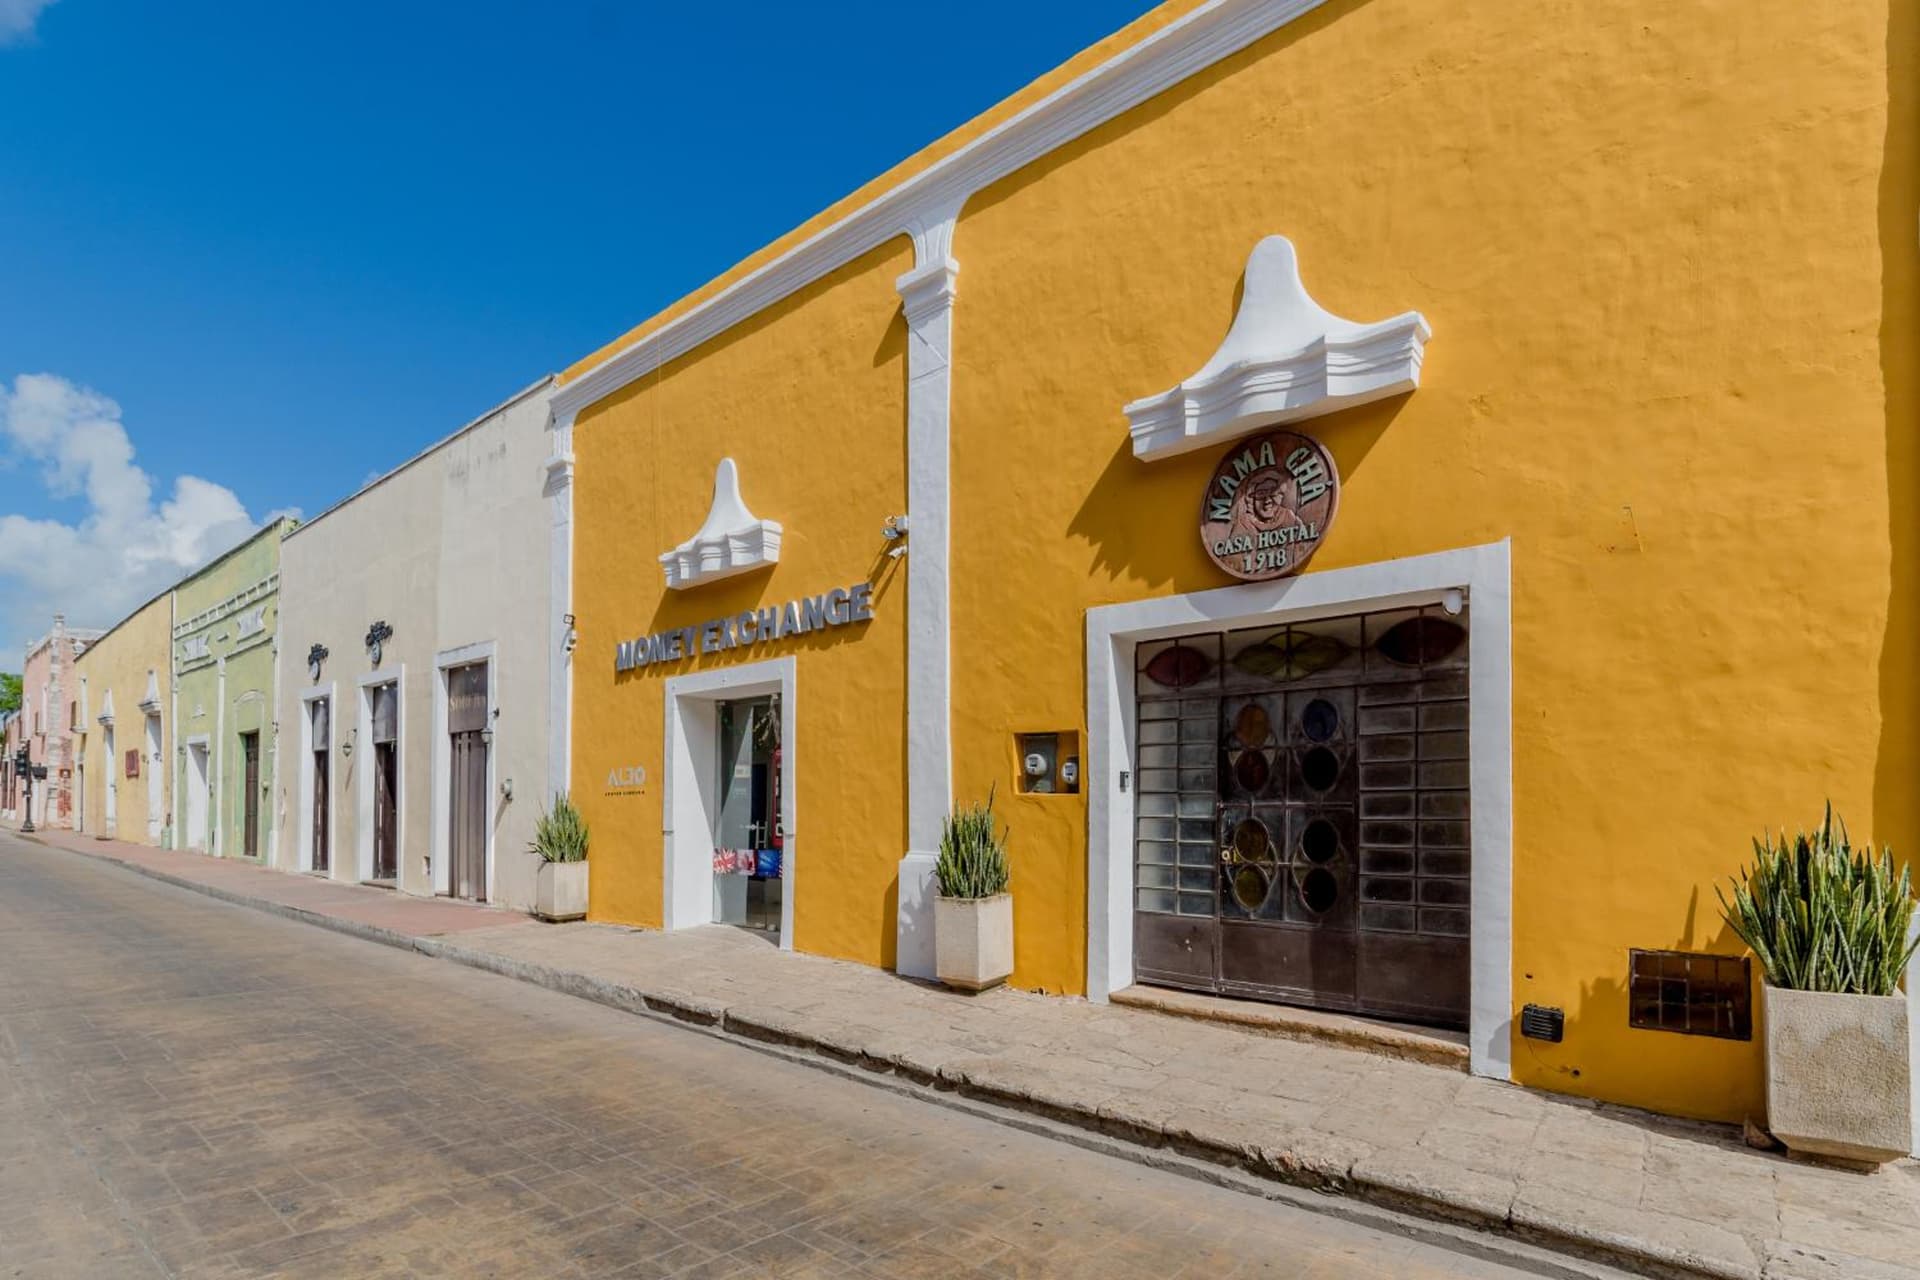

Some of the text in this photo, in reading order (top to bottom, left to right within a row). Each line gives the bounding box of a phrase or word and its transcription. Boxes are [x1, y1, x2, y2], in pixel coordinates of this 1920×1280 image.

[1210, 442, 1276, 521] MAMA
[1214, 522, 1320, 555] CASA HOSTAL
[1243, 549, 1287, 572] 1918
[615, 582, 874, 672] MONEY EXCHANGE
